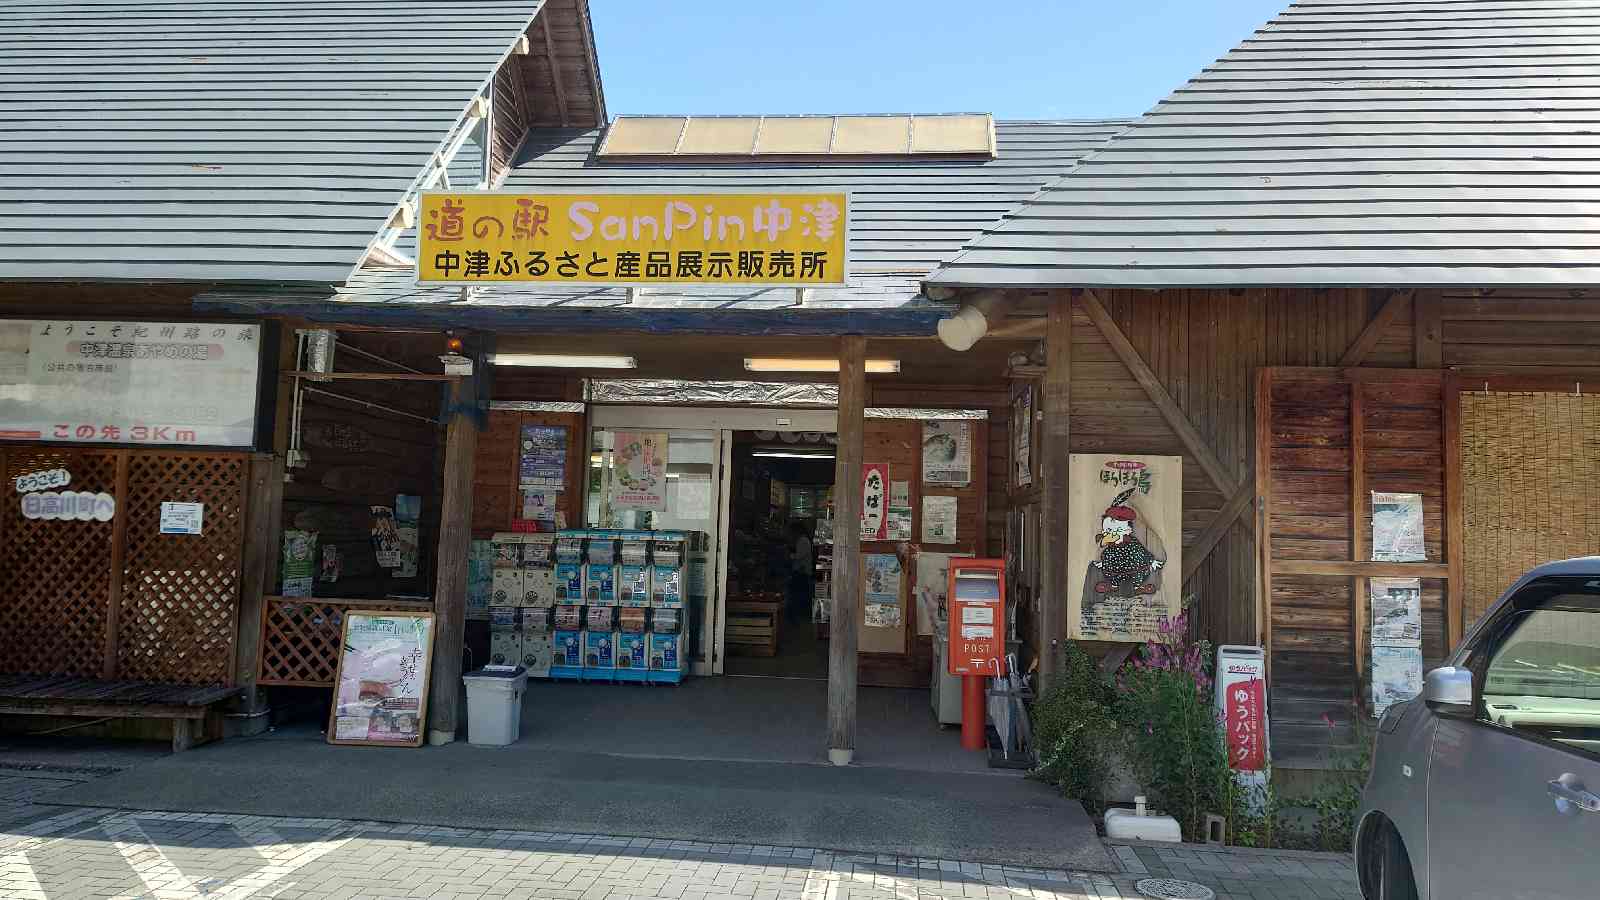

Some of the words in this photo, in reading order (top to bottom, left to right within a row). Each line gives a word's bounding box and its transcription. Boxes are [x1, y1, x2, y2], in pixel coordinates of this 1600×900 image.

[425, 198, 549, 241] 道の駅
[568, 200, 841, 241] SanPin中津
[434, 249, 828, 279] 中津ふるさと産品展示販売所
[24, 499, 112, 516] 日高川町へ
[964, 644, 991, 653] POST
[1234, 689, 1251, 761] ゆうパック
